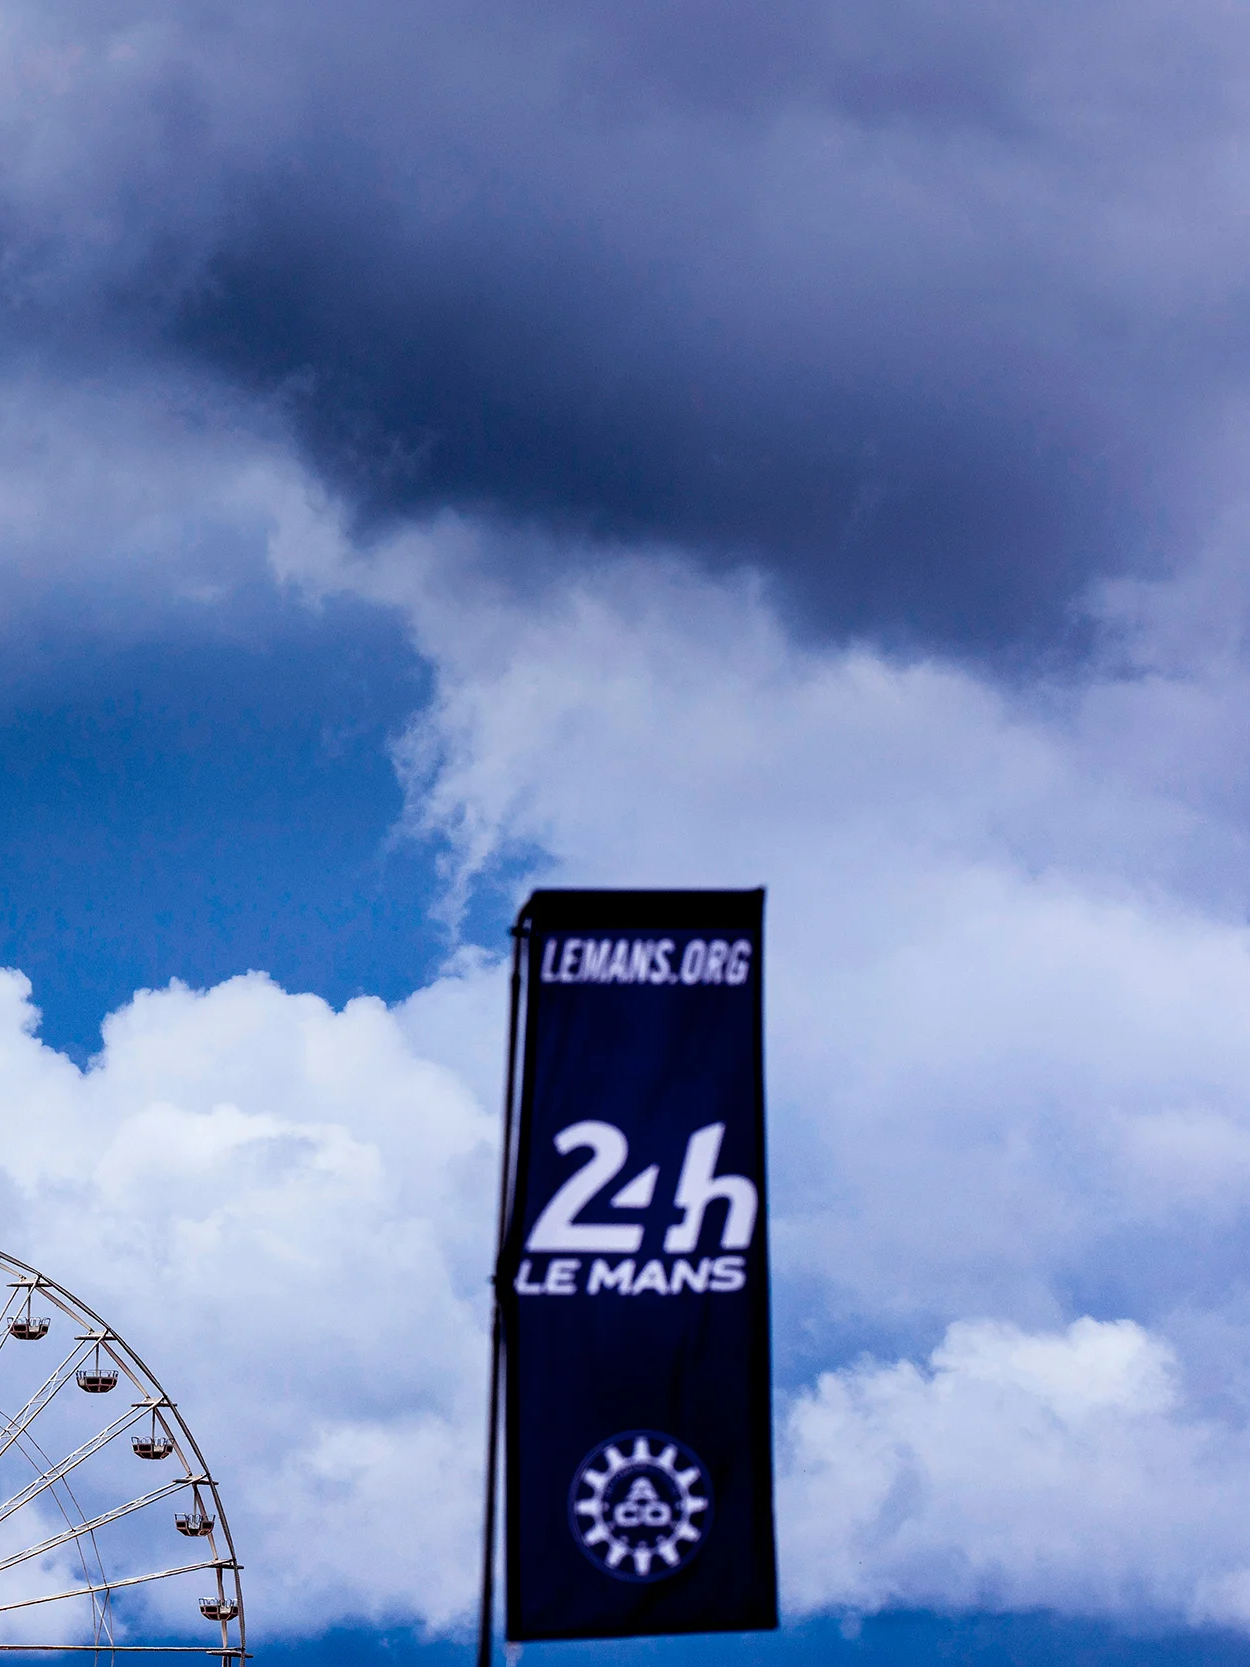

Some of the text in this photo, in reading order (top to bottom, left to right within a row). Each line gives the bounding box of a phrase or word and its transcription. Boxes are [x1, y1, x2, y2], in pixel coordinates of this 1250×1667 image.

[541, 938, 751, 985] LEMANS.ORG
[514, 1255, 746, 1295] LE MANS
